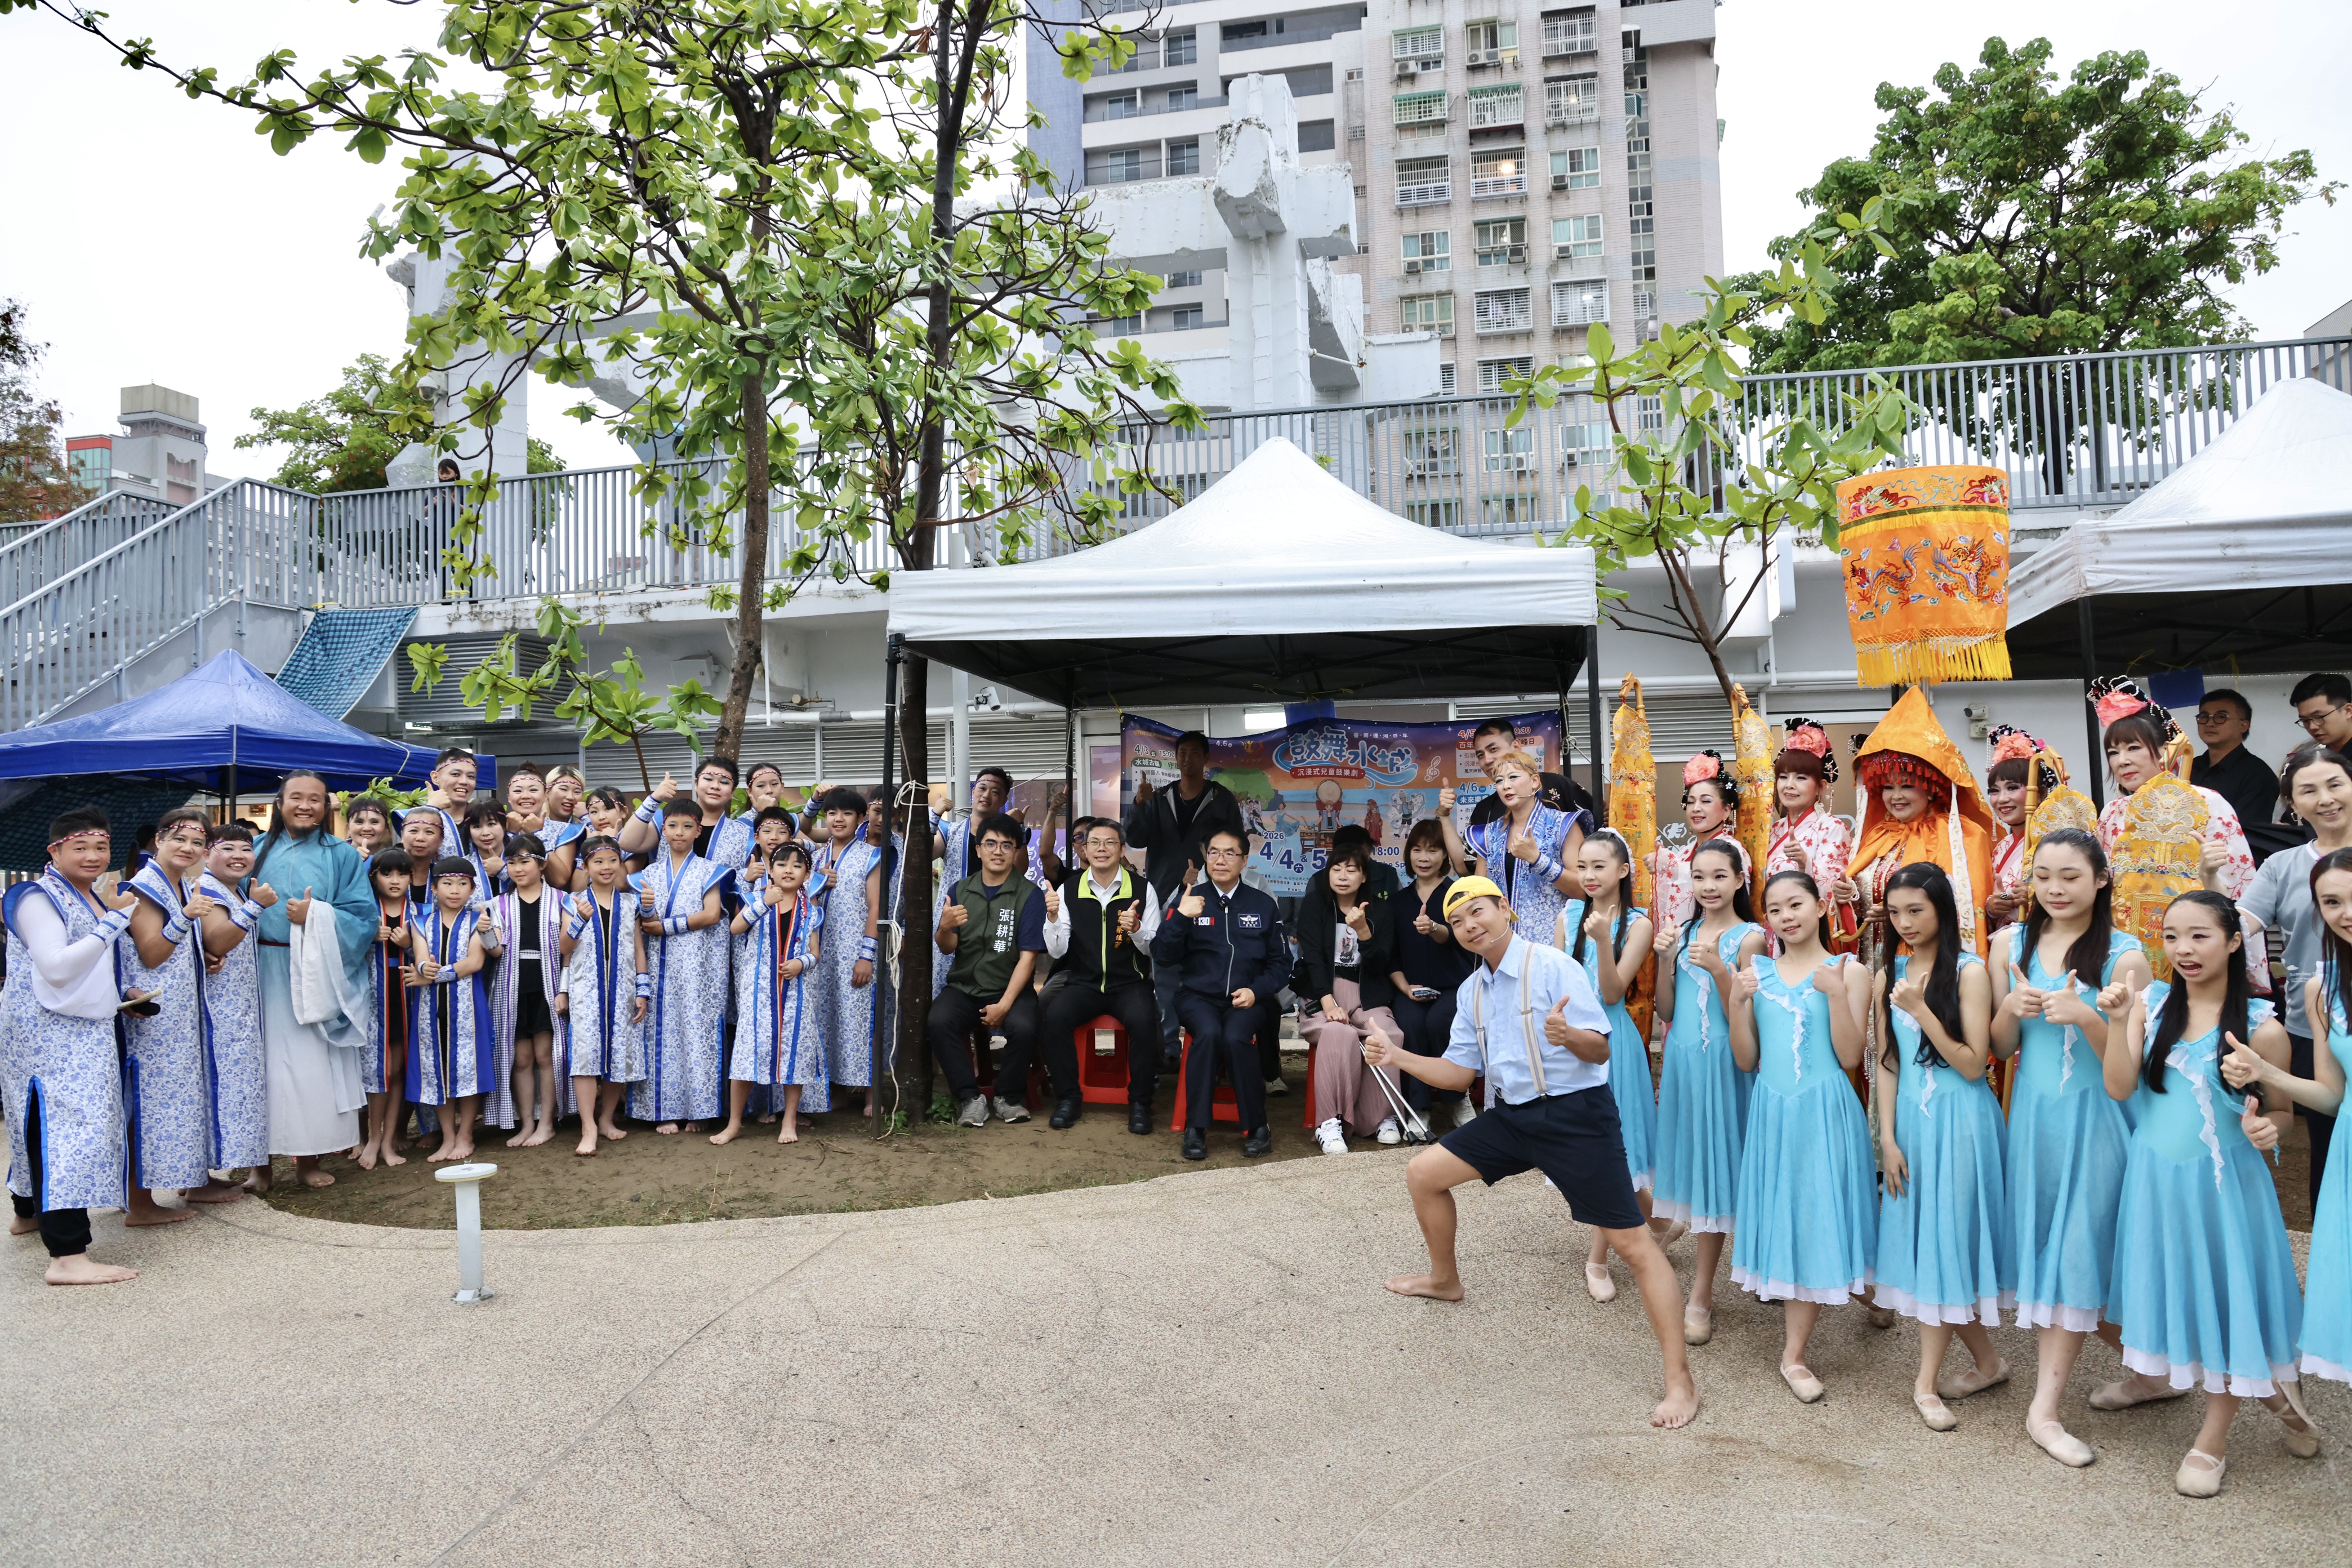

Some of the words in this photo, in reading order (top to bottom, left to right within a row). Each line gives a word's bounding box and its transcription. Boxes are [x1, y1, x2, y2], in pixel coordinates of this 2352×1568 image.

[1458, 729, 1476, 740] 4/5
[1134, 744, 1149, 756] 4/3
[1159, 750, 1175, 758] 15:00
[1289, 725, 1411, 774] 鼓舞水城
[1297, 768, 1358, 777] 沉浸式兒童鼓樂劇
[1459, 782, 1478, 794] 4/6
[1259, 841, 1294, 870] 4/4
[1312, 849, 1326, 870] 5
[993, 908, 1010, 953] 張耕華
